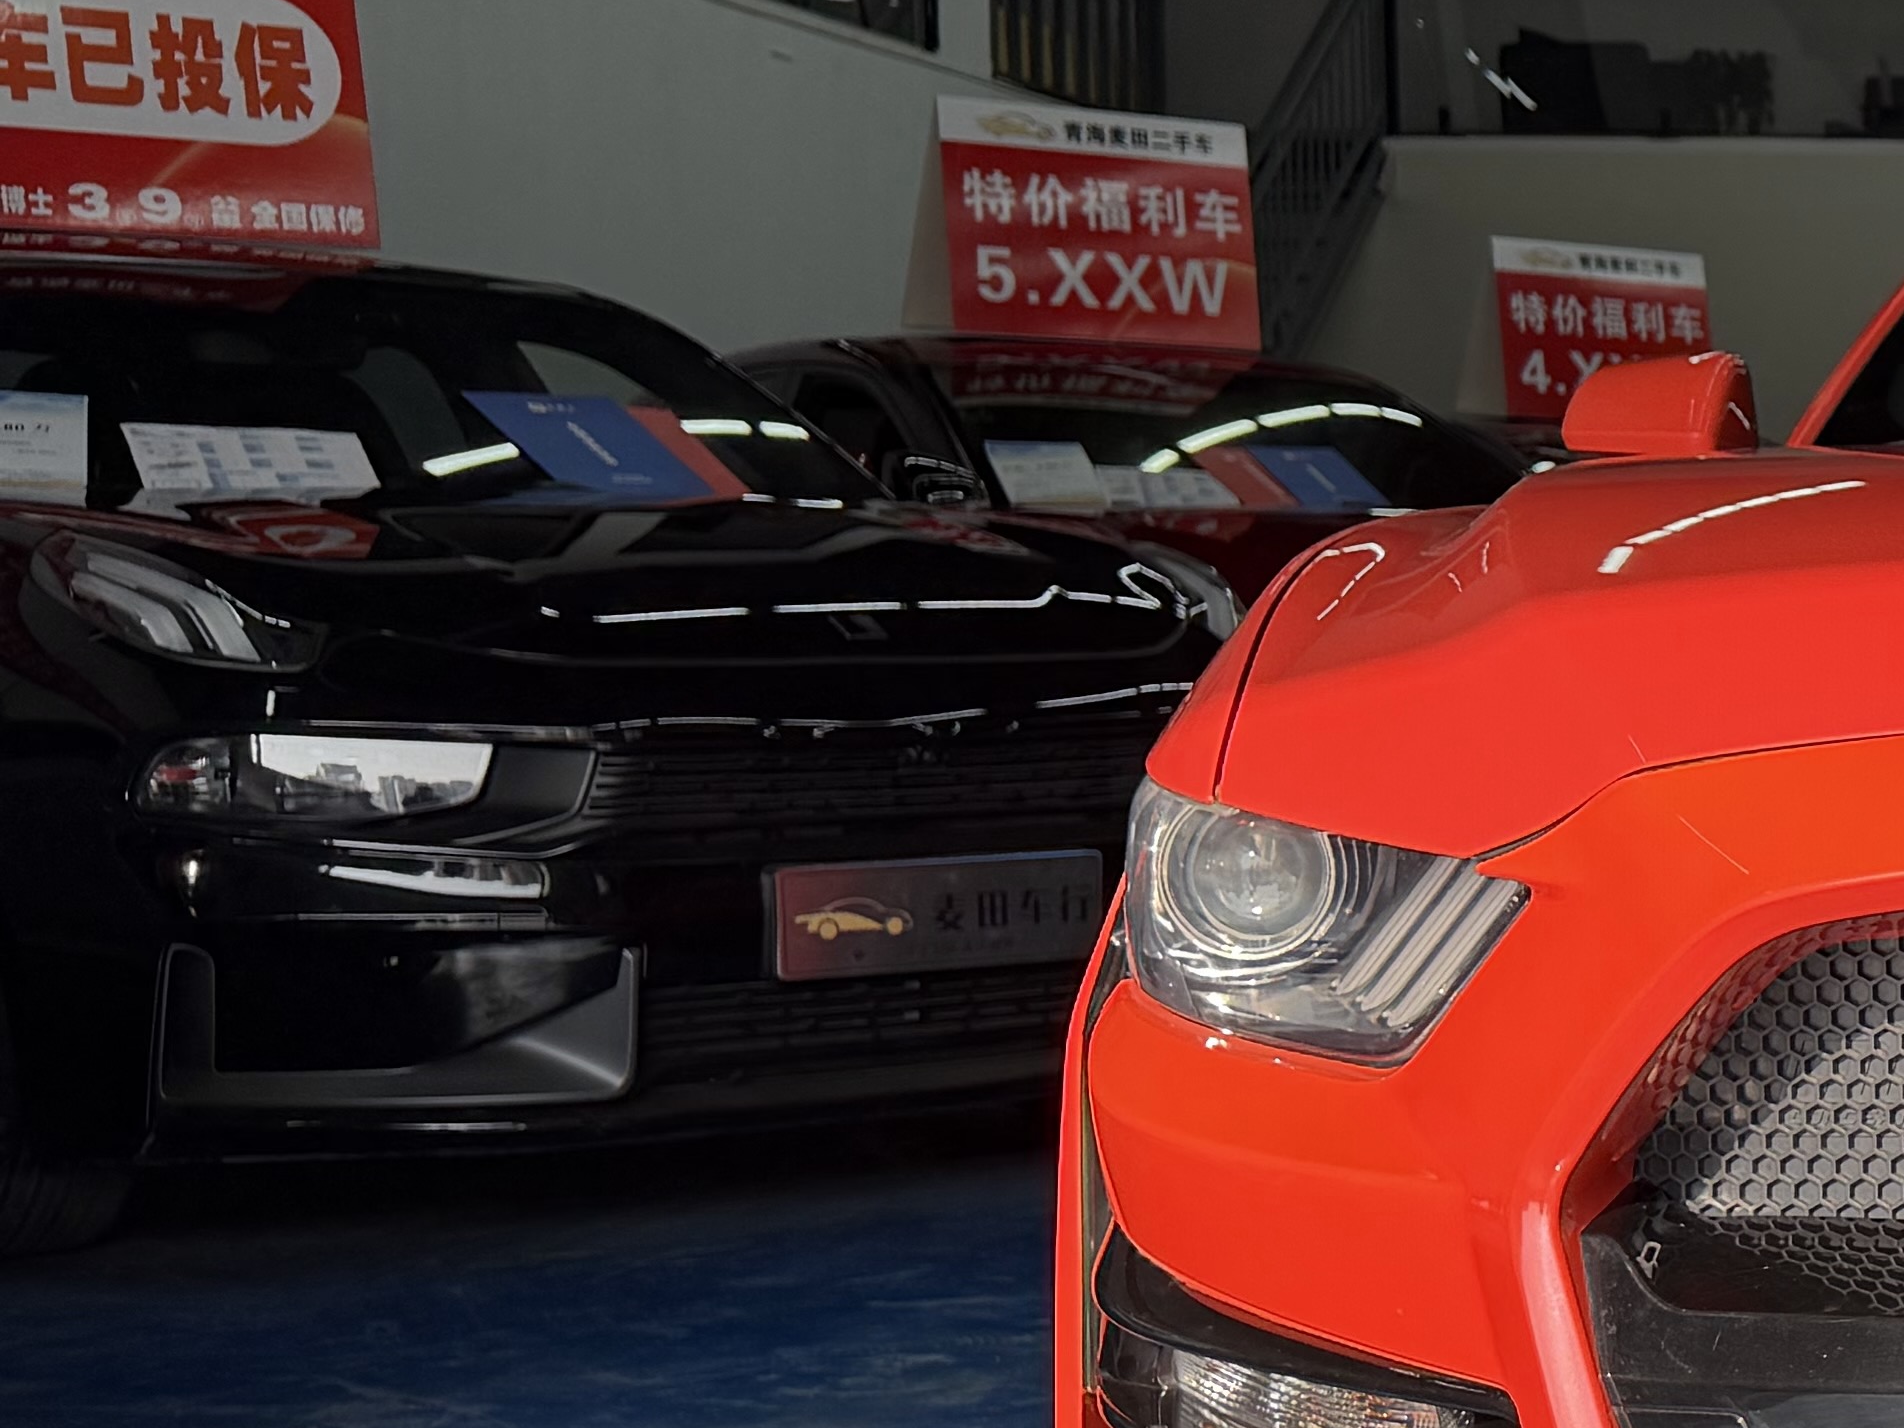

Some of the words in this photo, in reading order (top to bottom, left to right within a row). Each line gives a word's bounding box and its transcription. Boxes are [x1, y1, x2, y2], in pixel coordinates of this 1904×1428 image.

[1063, 119, 1214, 154] 青海麦田二手车
[963, 167, 1242, 243] 特价福利车
[976, 244, 1229, 318] 5.XXW
[1510, 290, 1704, 345] 特价福利车
